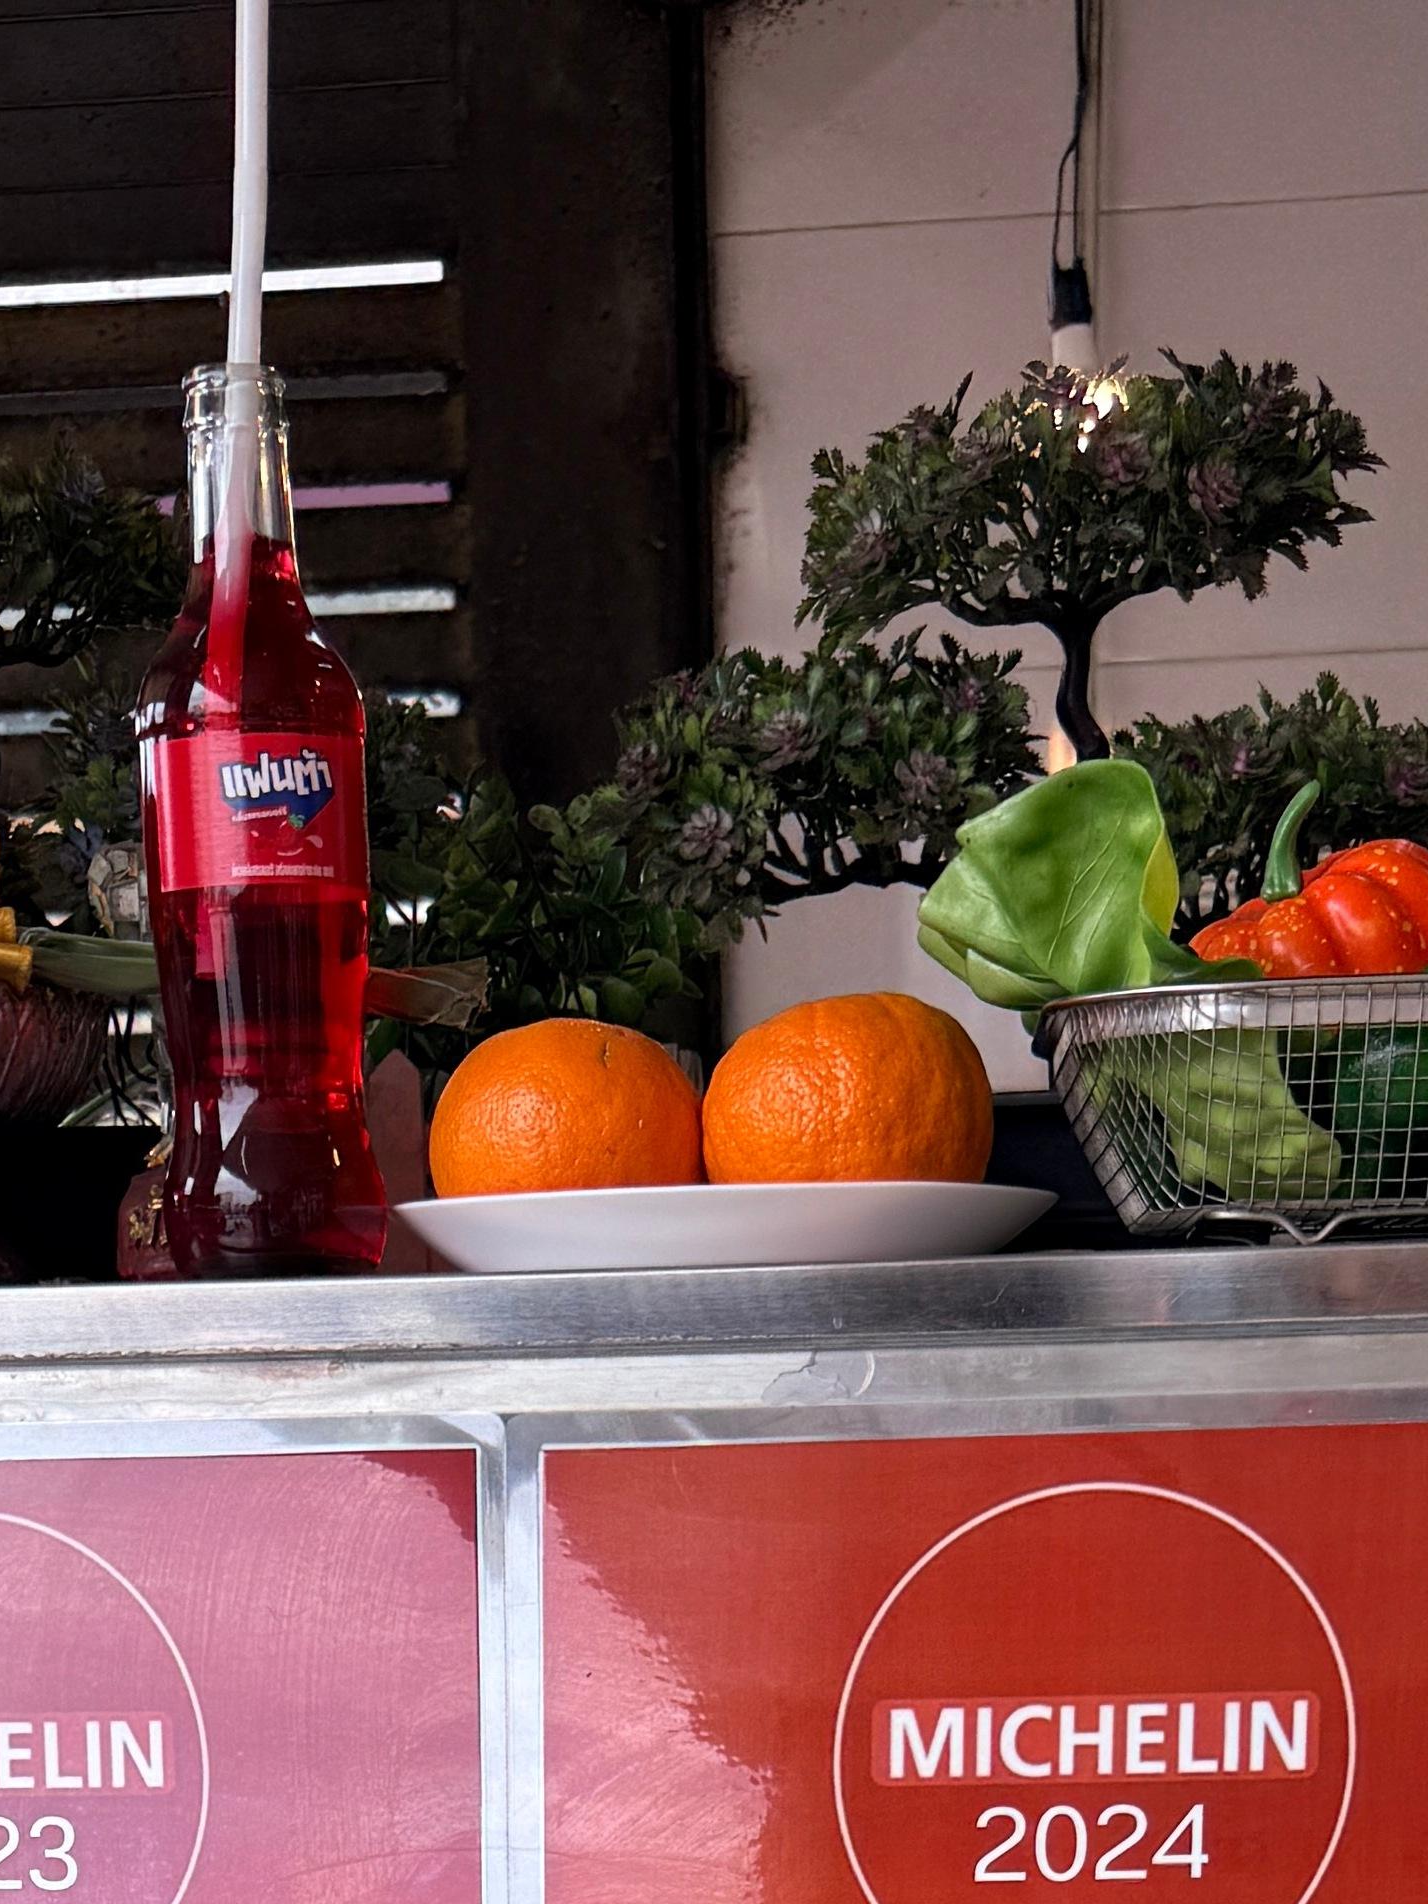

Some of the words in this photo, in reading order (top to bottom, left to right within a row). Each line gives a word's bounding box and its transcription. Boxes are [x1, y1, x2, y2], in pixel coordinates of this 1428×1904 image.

[221, 749, 333, 799] แฟนต้า
[891, 1701, 1307, 1777] MICHELIN
[975, 1805, 1208, 1881] 2024
